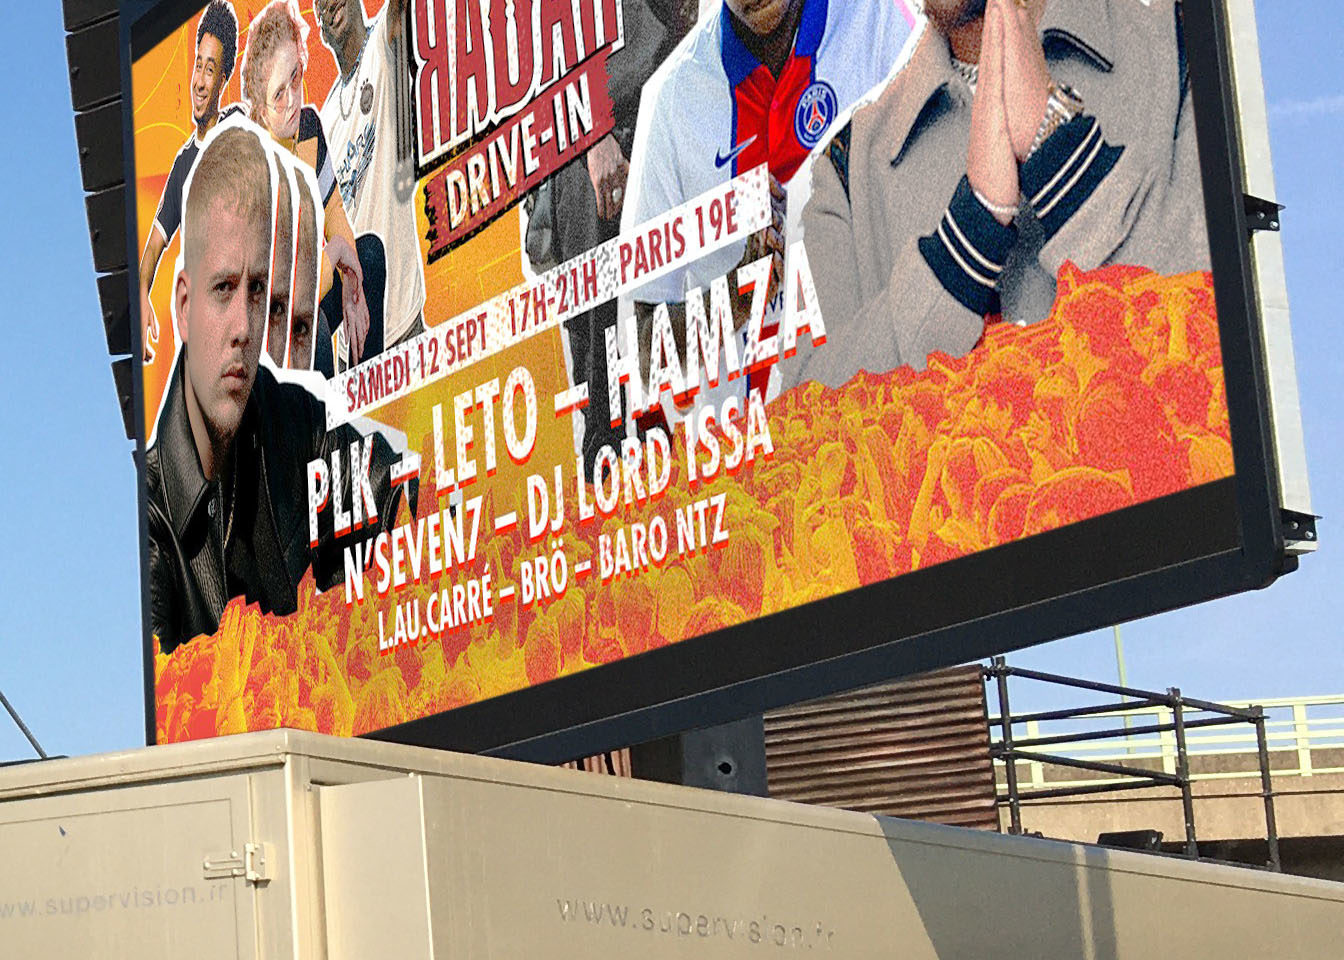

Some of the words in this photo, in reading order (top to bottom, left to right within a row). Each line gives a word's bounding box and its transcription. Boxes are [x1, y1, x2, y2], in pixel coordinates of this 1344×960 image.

[445, 71, 593, 230] DRIVE-IN
[346, 350, 410, 413] SAMEDI
[418, 337, 440, 379] 12
[446, 312, 488, 366] SEPT
[508, 258, 599, 336] 17H-21H
[619, 217, 686, 284] PARIS
[695, 190, 738, 248] 19E
[306, 434, 378, 548] PLK
[432, 366, 538, 498] LETO
[605, 240, 827, 428] HAMZA
[526, 465, 563, 543] DJ
[576, 426, 671, 526] LORD
[683, 387, 774, 490] ISSA
[378, 563, 494, 656] L.AU.CARRÉ
[520, 539, 567, 611] BRÖ
[598, 515, 668, 586] BARO
[675, 492, 729, 561] NTZ
